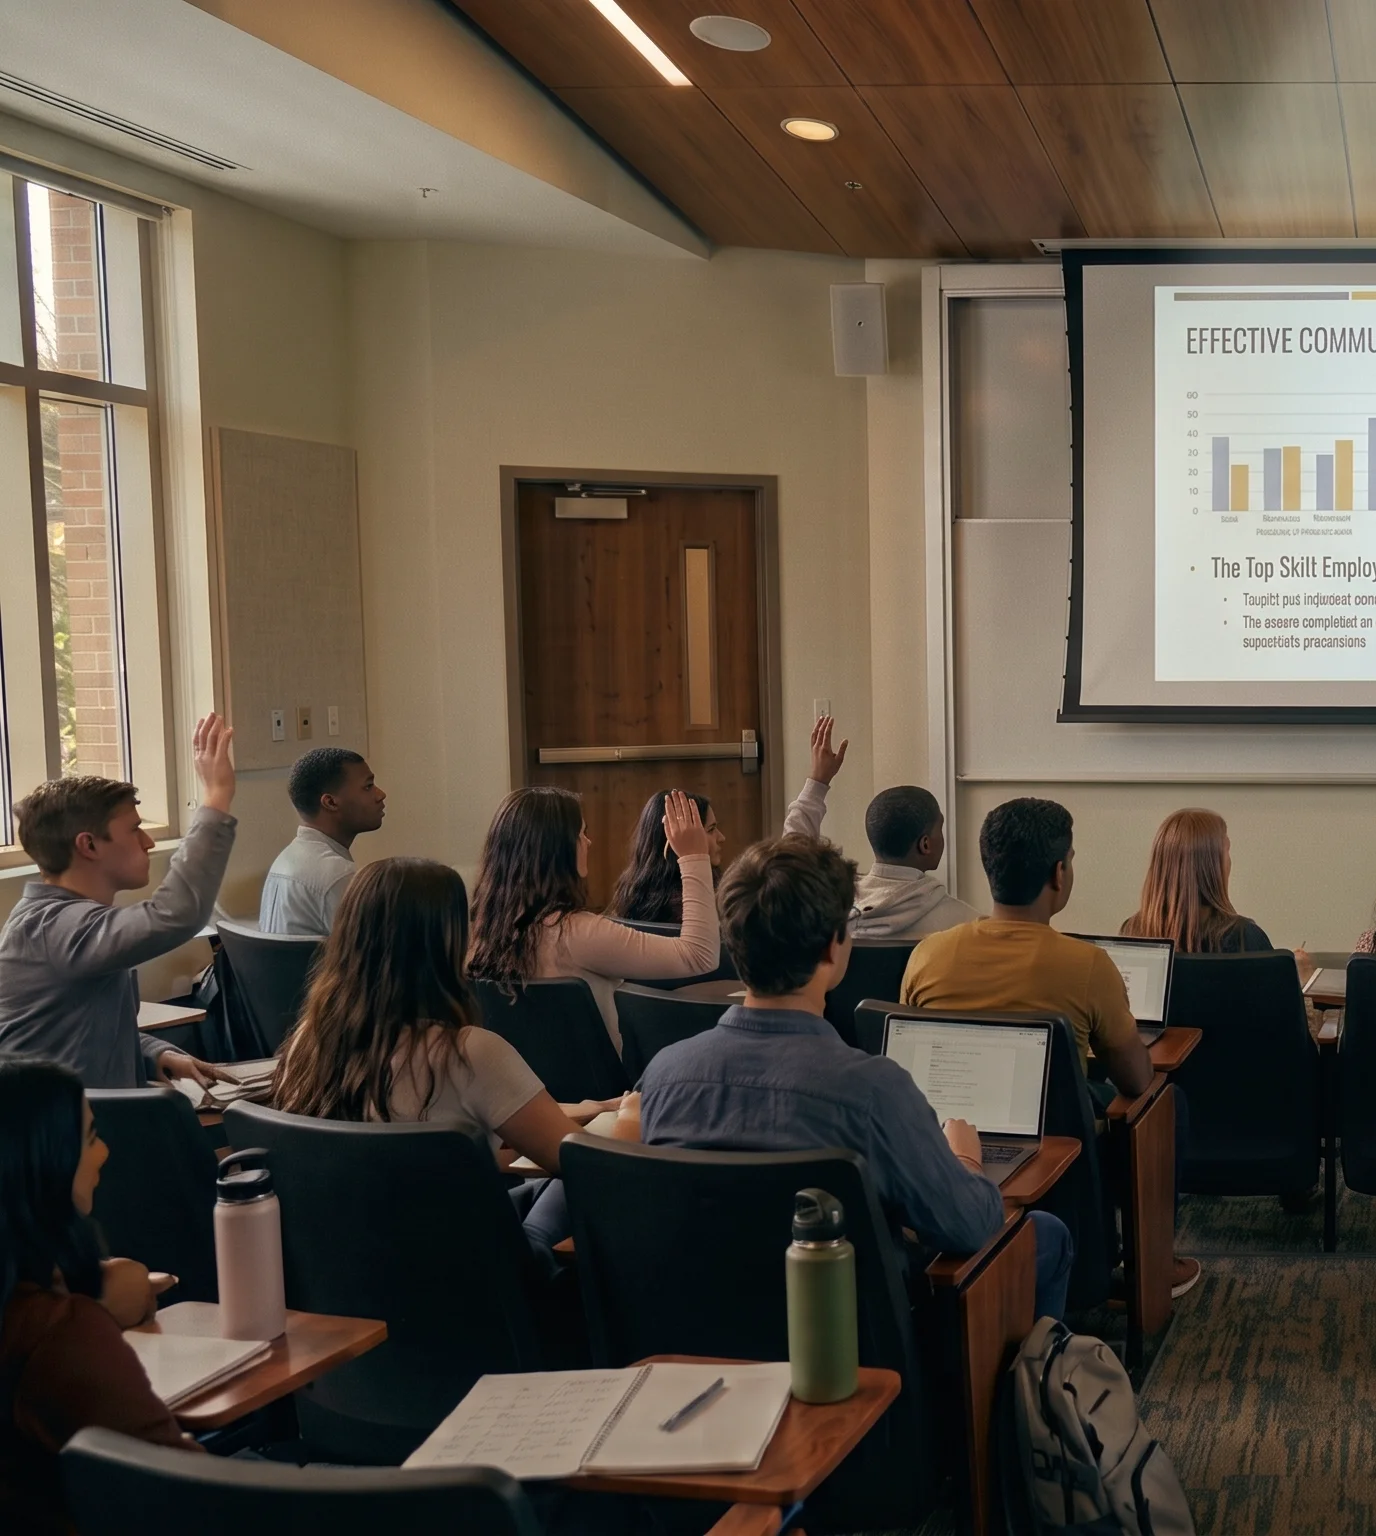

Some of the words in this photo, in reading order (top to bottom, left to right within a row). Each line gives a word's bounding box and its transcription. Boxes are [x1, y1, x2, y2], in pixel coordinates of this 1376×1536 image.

[1187, 327, 1293, 354] EFFECTIVE
[1187, 410, 1199, 419] 50
[1187, 429, 1199, 438] 40
[1188, 468, 1199, 477] 20
[1189, 487, 1199, 496] 10
[1191, 506, 1199, 516] 0
[1211, 557, 1240, 578] The
[1245, 557, 1274, 583] Top
[1243, 615, 1261, 628] The
[1360, 617, 1372, 629] an
